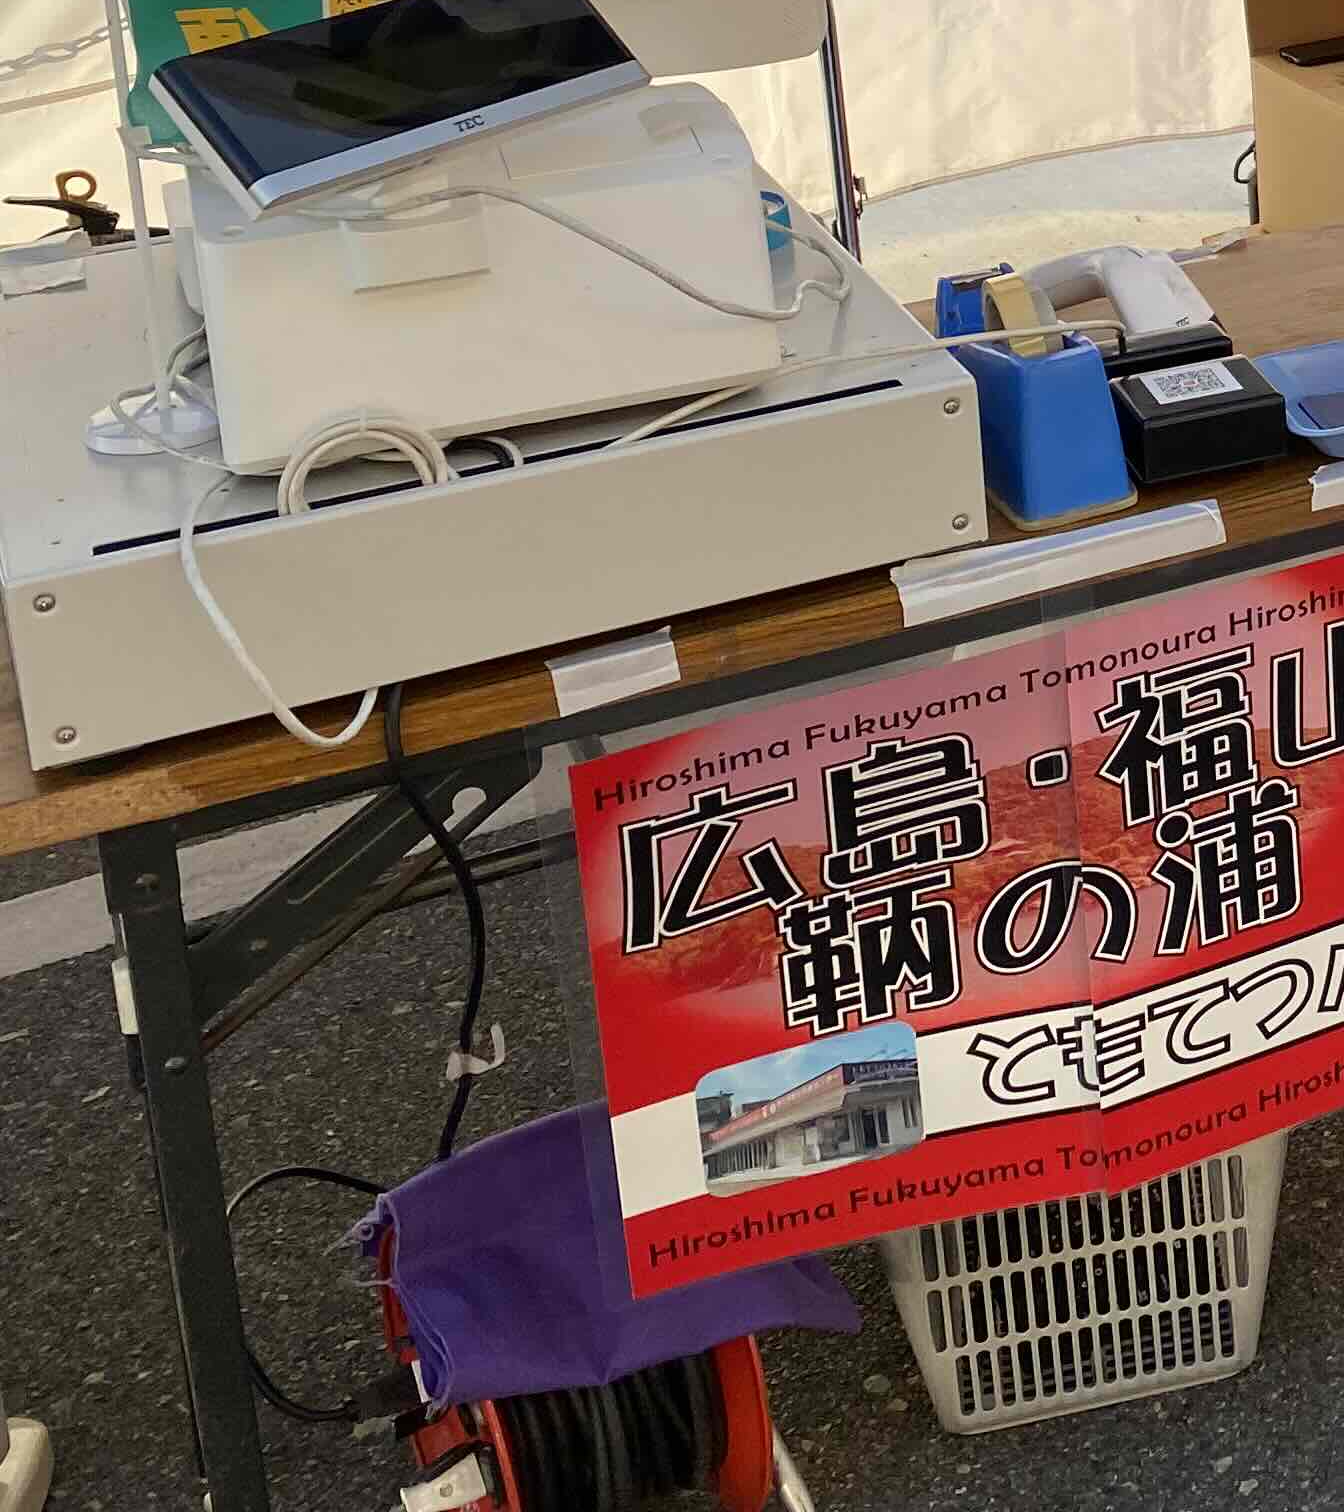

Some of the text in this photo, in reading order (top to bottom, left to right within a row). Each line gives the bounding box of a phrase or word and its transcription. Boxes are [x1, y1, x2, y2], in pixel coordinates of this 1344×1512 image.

[454, 114, 485, 133] TEC
[592, 742, 791, 813] Hiroshima
[803, 680, 1009, 751] Fukuyama
[1019, 622, 1217, 694] Tomonoura
[777, 780, 1303, 1037] 鞆の浦
[648, 1198, 837, 1269] Hiroshima
[848, 1156, 1046, 1228] Fukuyama
[1057, 1100, 1249, 1175] Tomonoura
